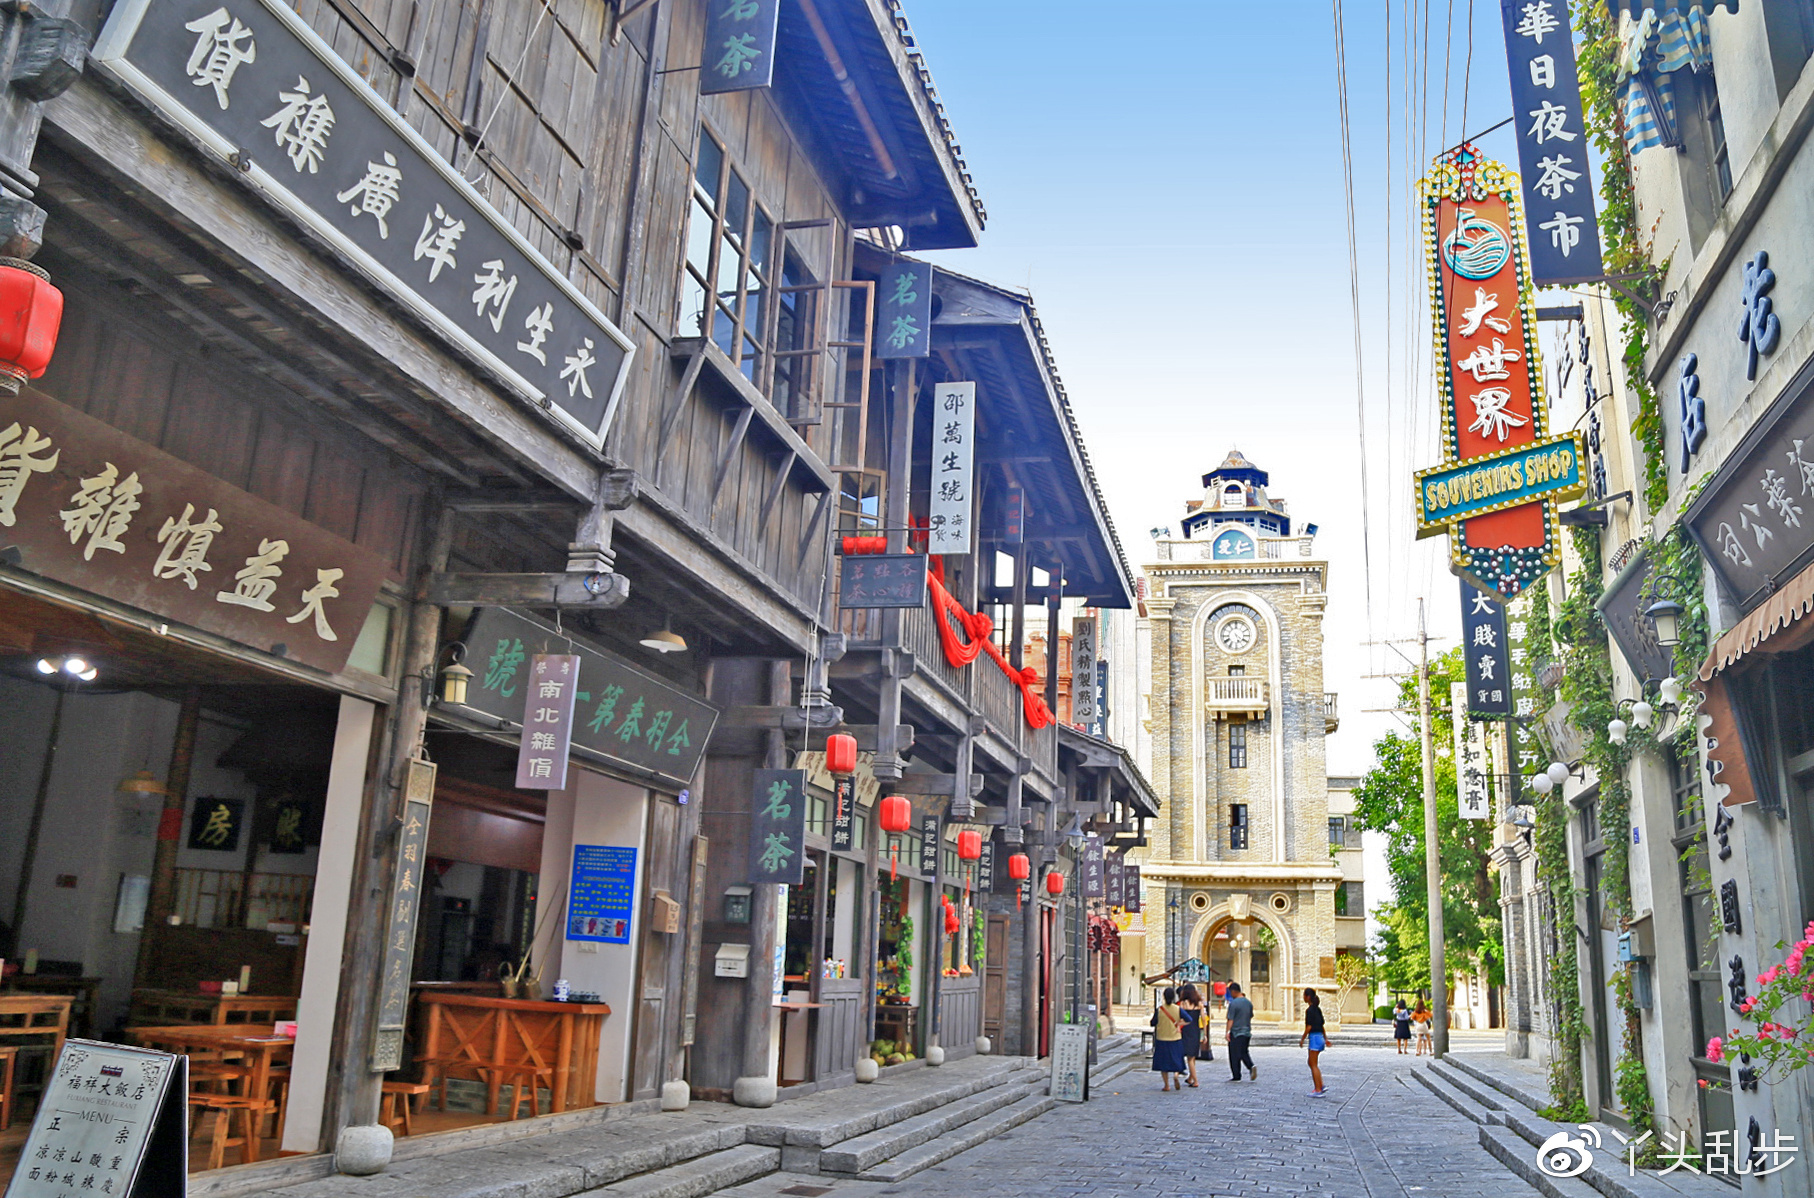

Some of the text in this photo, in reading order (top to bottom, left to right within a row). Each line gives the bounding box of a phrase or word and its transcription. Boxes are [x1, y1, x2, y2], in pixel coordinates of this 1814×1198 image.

[1515, 1, 1584, 257] 華日夜茶市
[887, 272, 921, 349] 茗茶
[1458, 287, 1529, 442] 大世界
[937, 393, 965, 502] 邵萬生號
[1426, 448, 1574, 511] SOUVENIRS SHOP
[951, 514, 964, 540] 海味
[759, 779, 796, 874] 茗茶
[67, 1074, 146, 1100] 福祥大飯店
[79, 1110, 114, 1124] MENU
[96, 1098, 138, 1110] RESTAURANT
[47, 1117, 129, 1144] 正 宗
